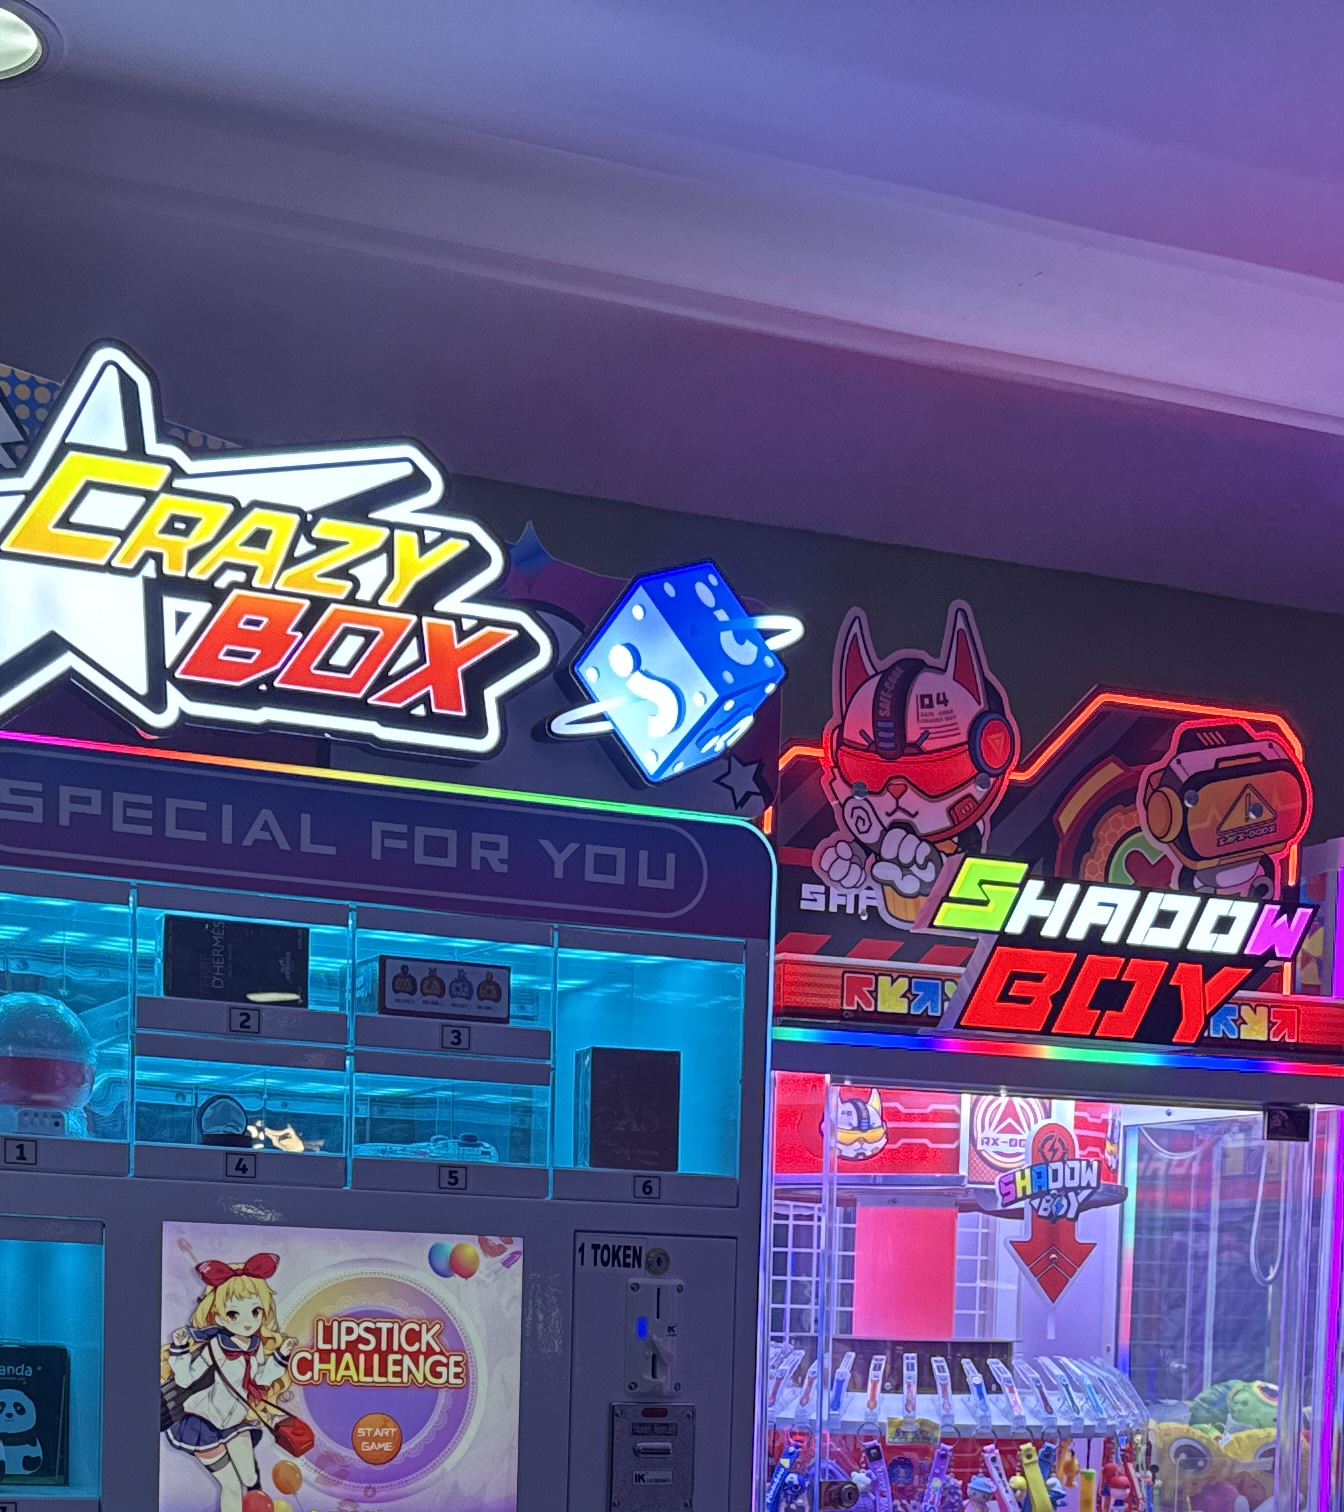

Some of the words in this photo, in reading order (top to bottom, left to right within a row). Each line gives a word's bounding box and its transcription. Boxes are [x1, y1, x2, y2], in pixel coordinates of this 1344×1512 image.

[176, 590, 518, 717] BOX
[371, 820, 510, 874] FOR
[538, 837, 677, 892] YOU
[933, 857, 1311, 960] SHADOW
[959, 946, 1253, 1043] BOY
[239, 1012, 251, 1030] 2
[450, 1029, 462, 1046] 3
[15, 1143, 27, 1161] 1
[234, 1156, 249, 1175] 4
[447, 1169, 461, 1187] 5
[642, 1180, 653, 1196] 6
[998, 1160, 1099, 1206] SHADOW
[1038, 1188, 1092, 1220] BOY
[578, 1242, 585, 1266] 1
[591, 1243, 644, 1270] TOKEN
[316, 1319, 443, 1353] LIPSTICK
[290, 1351, 466, 1386] CHALLENGE
[357, 1427, 398, 1438] START
[361, 1441, 394, 1452] GAME
